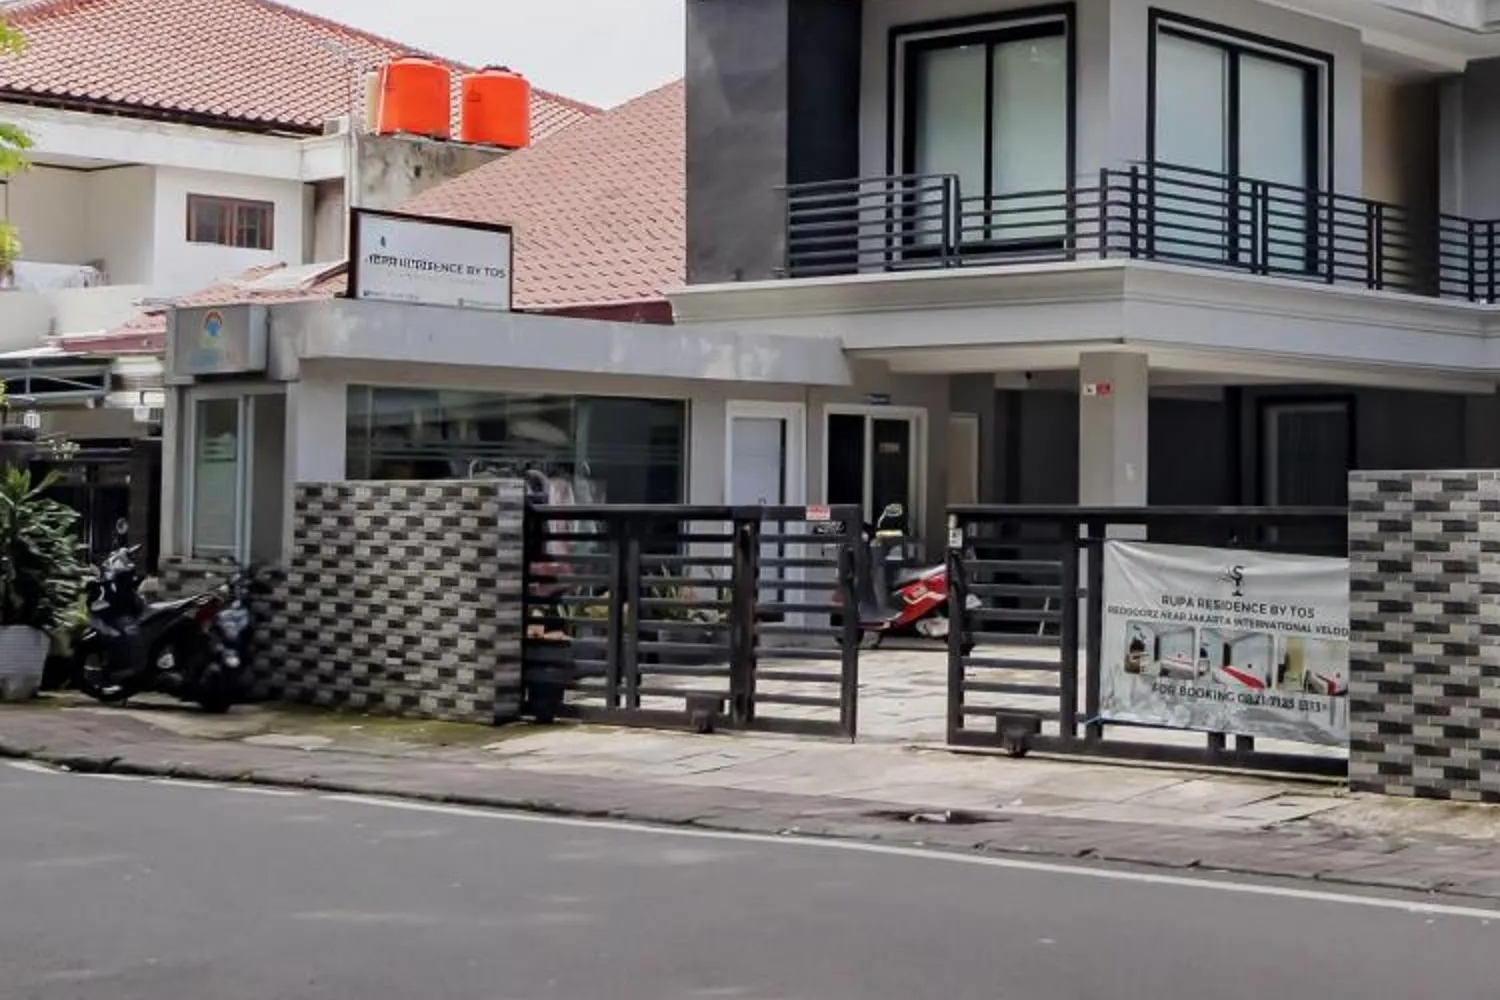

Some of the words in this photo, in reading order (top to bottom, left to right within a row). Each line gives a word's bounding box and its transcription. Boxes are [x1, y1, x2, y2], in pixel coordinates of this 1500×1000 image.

[1161, 594, 1195, 608] RUPA
[1198, 597, 1267, 615] RESIDENCE
[1269, 603, 1288, 615] BY
[1290, 604, 1315, 618] TOS
[1159, 610, 1186, 621] NEAR
[1187, 613, 1231, 625] JAKARTA
[1232, 616, 1311, 632] INTERNATIONAL
[1151, 682, 1176, 695] FOR
[1178, 685, 1236, 703] BOOKING
